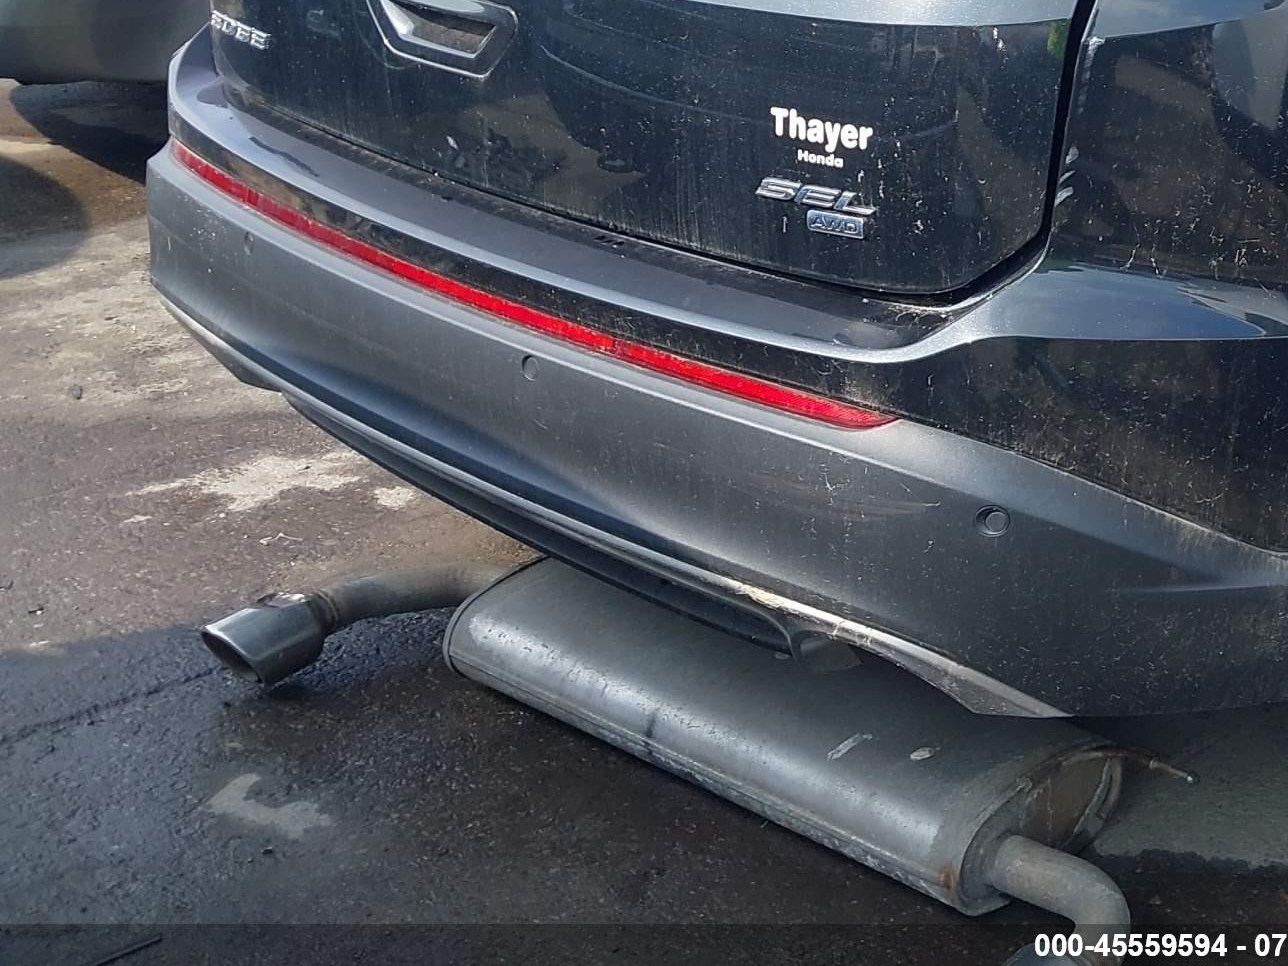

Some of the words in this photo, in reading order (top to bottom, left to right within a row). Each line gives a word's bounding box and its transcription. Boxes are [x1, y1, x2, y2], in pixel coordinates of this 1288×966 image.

[769, 106, 874, 153] Thayer
[796, 149, 844, 168] Honda
[755, 176, 877, 215] SEL
[809, 214, 861, 236] AWD
